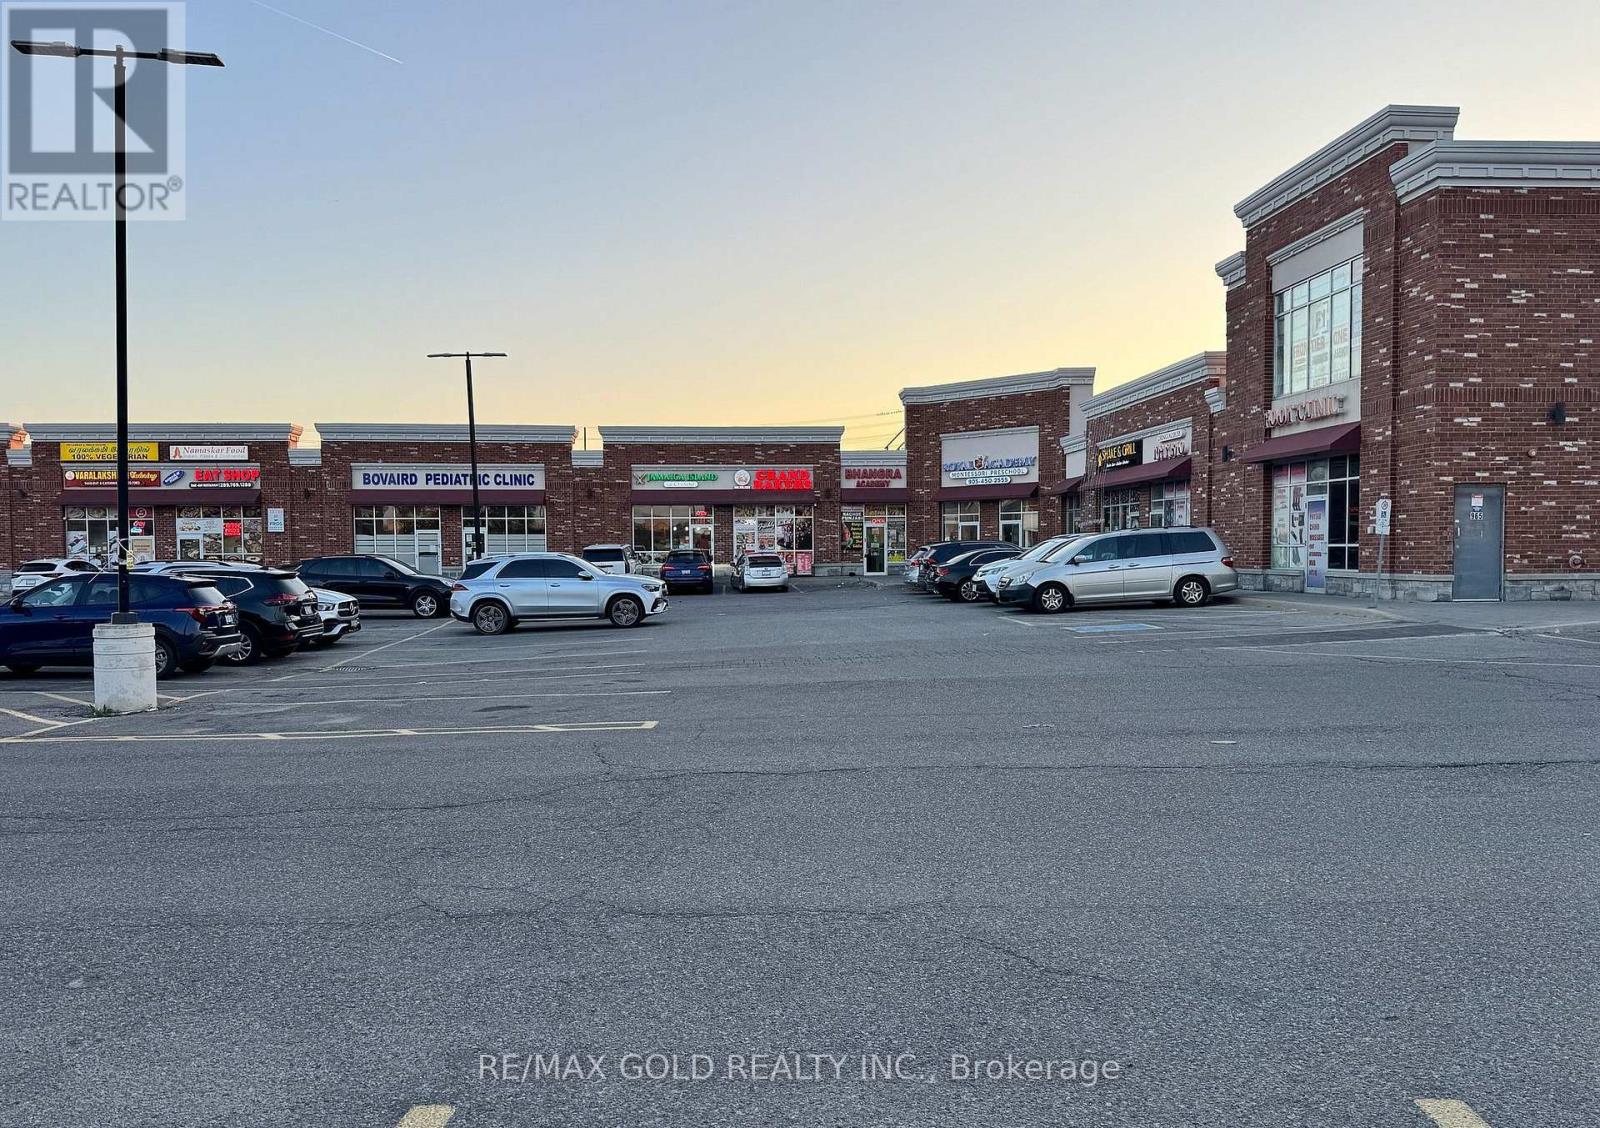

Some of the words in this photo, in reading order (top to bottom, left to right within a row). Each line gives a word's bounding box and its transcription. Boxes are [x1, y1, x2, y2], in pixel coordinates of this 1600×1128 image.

[183, 446, 224, 454] Namaskar
[226, 446, 246, 454] Food
[943, 461, 973, 472] ROYAL
[983, 456, 1037, 470] ACADEMY
[75, 471, 129, 480] VARALAKSH
[194, 468, 220, 481] EAT
[223, 468, 260, 481] SHOP
[755, 469, 810, 480] GRAND
[990, 467, 1025, 476] PRESCHOOL
[362, 473, 418, 486] BOVAIRD
[493, 473, 535, 486] CLINIC
[1470, 512, 1484, 520] 965
